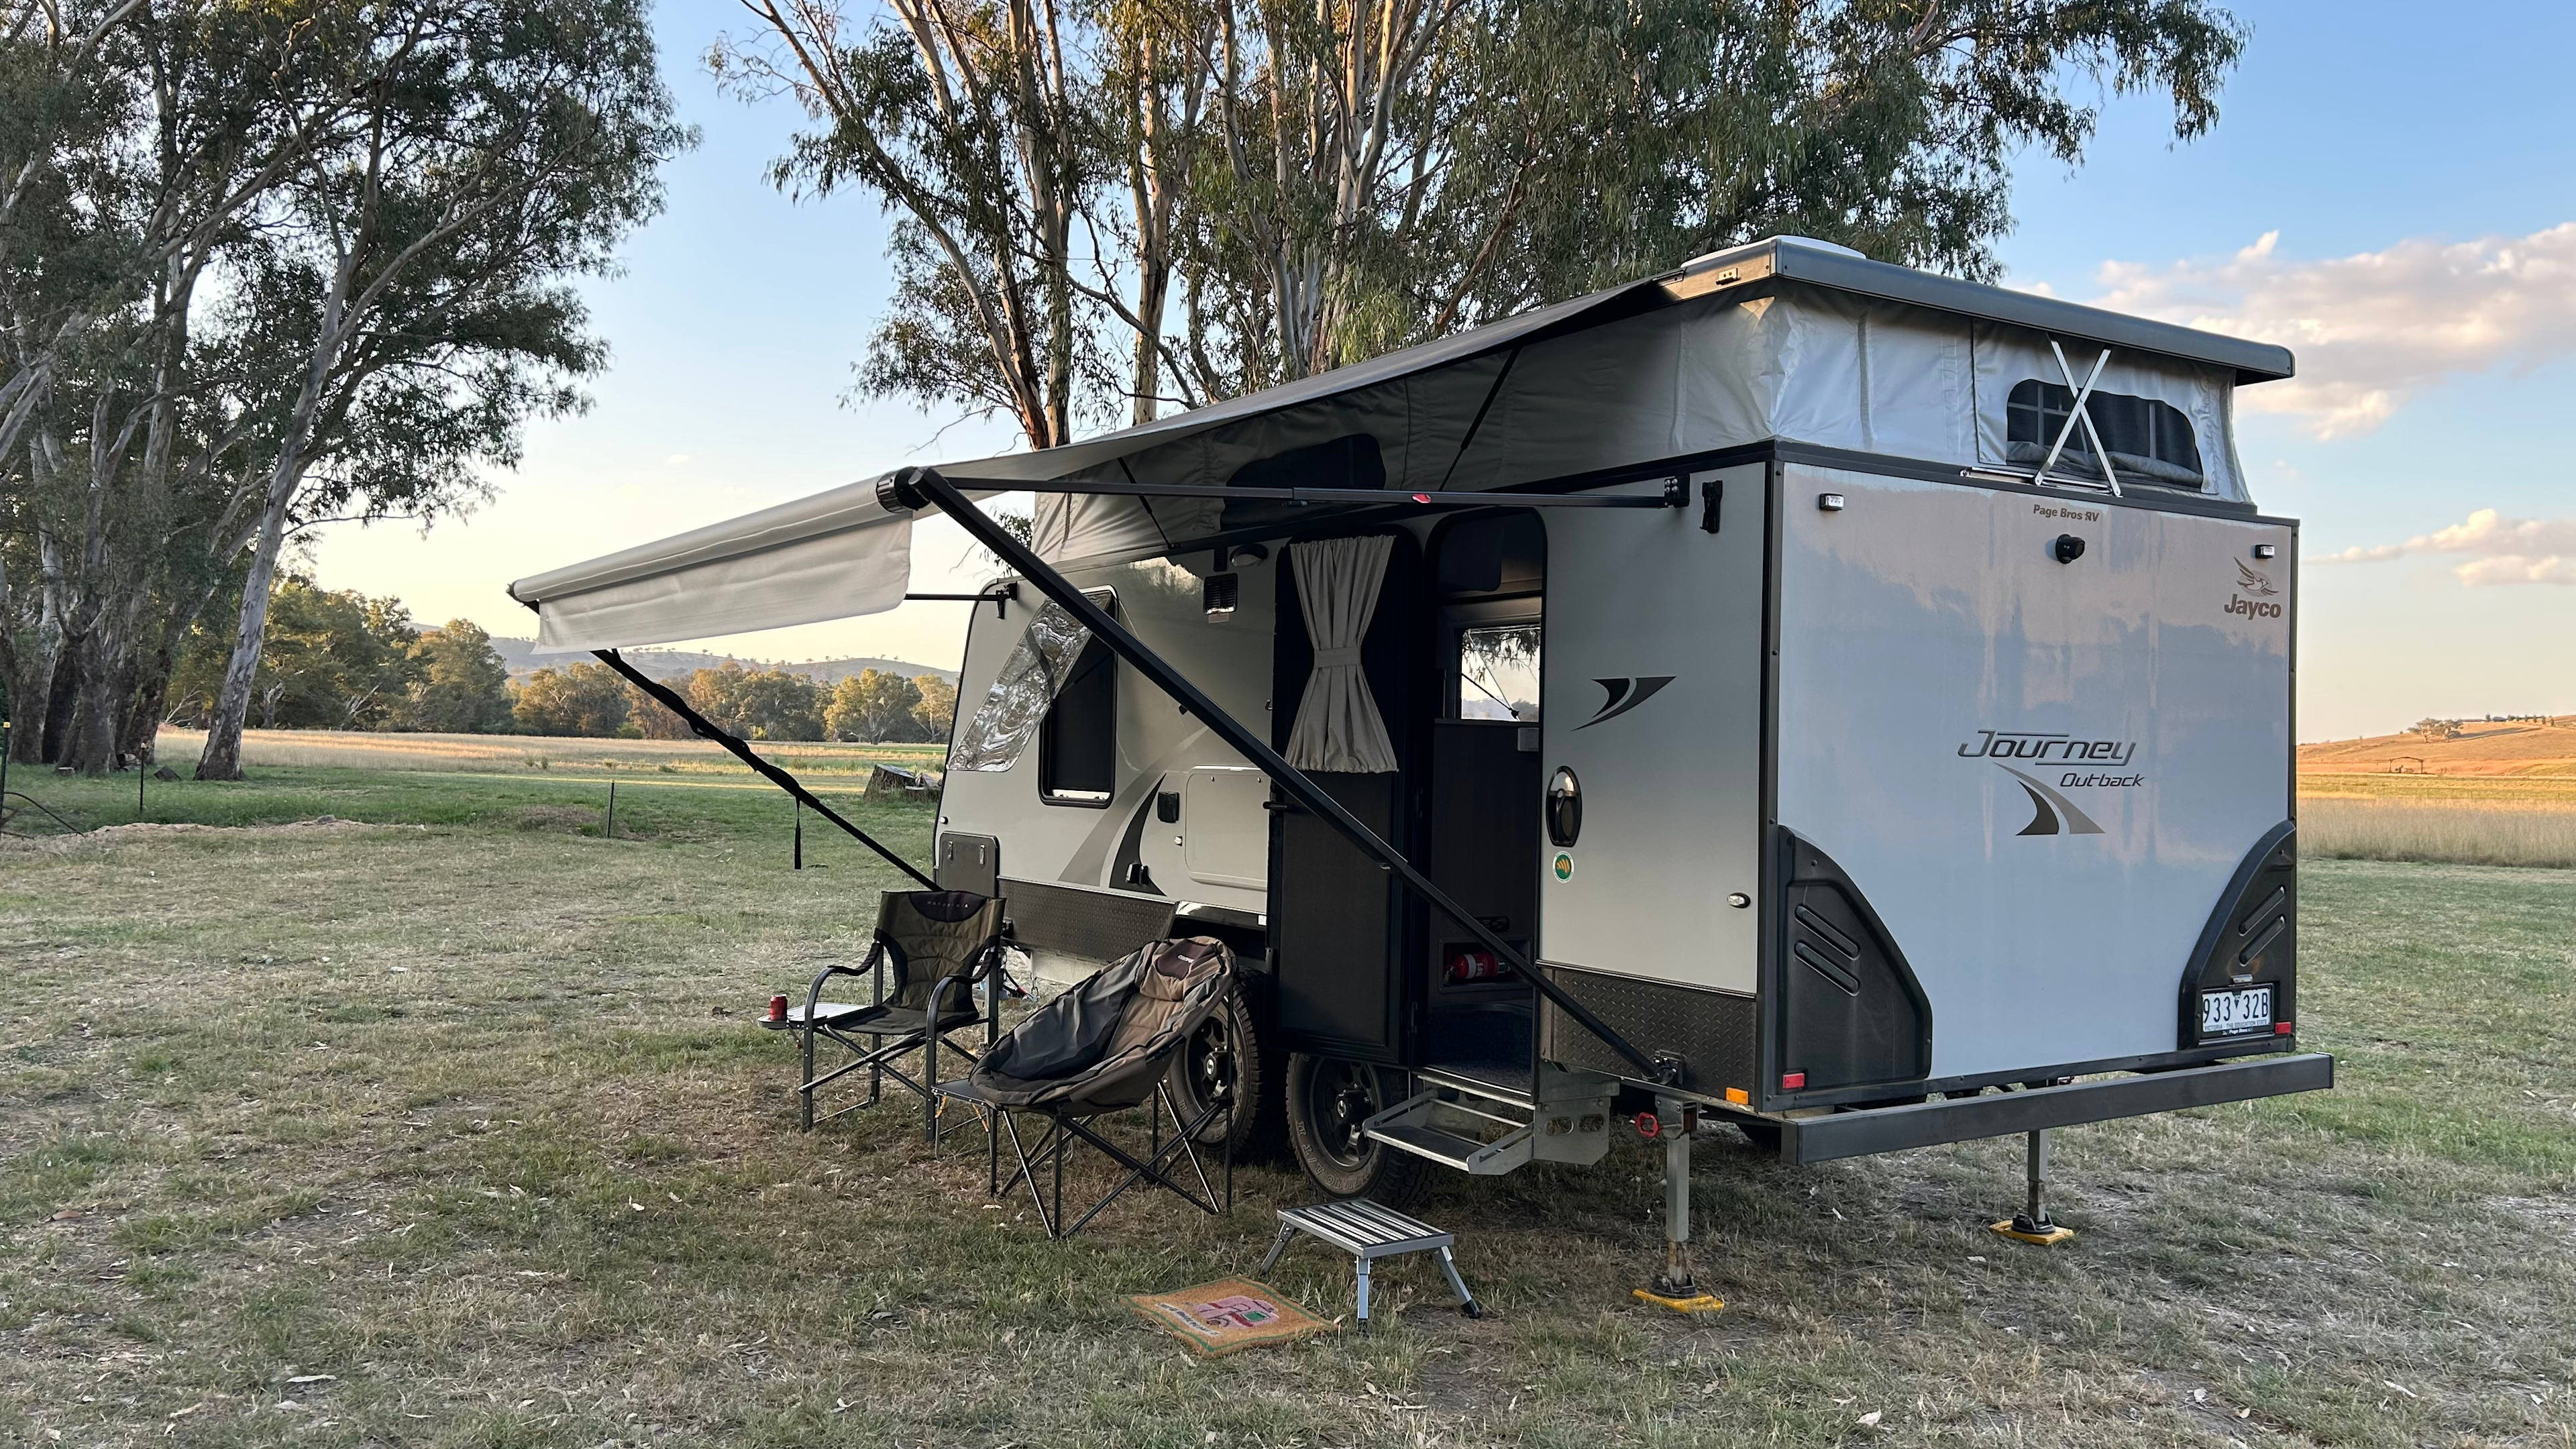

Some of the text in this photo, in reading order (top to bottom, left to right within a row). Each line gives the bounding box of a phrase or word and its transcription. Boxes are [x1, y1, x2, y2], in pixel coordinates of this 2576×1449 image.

[2033, 504, 2100, 522] Page Bros RV
[2224, 593, 2282, 621] Jayco
[1957, 729, 2137, 766] Journey
[2059, 772, 2145, 788] Outback
[2203, 992, 2268, 1023] 933 32B
